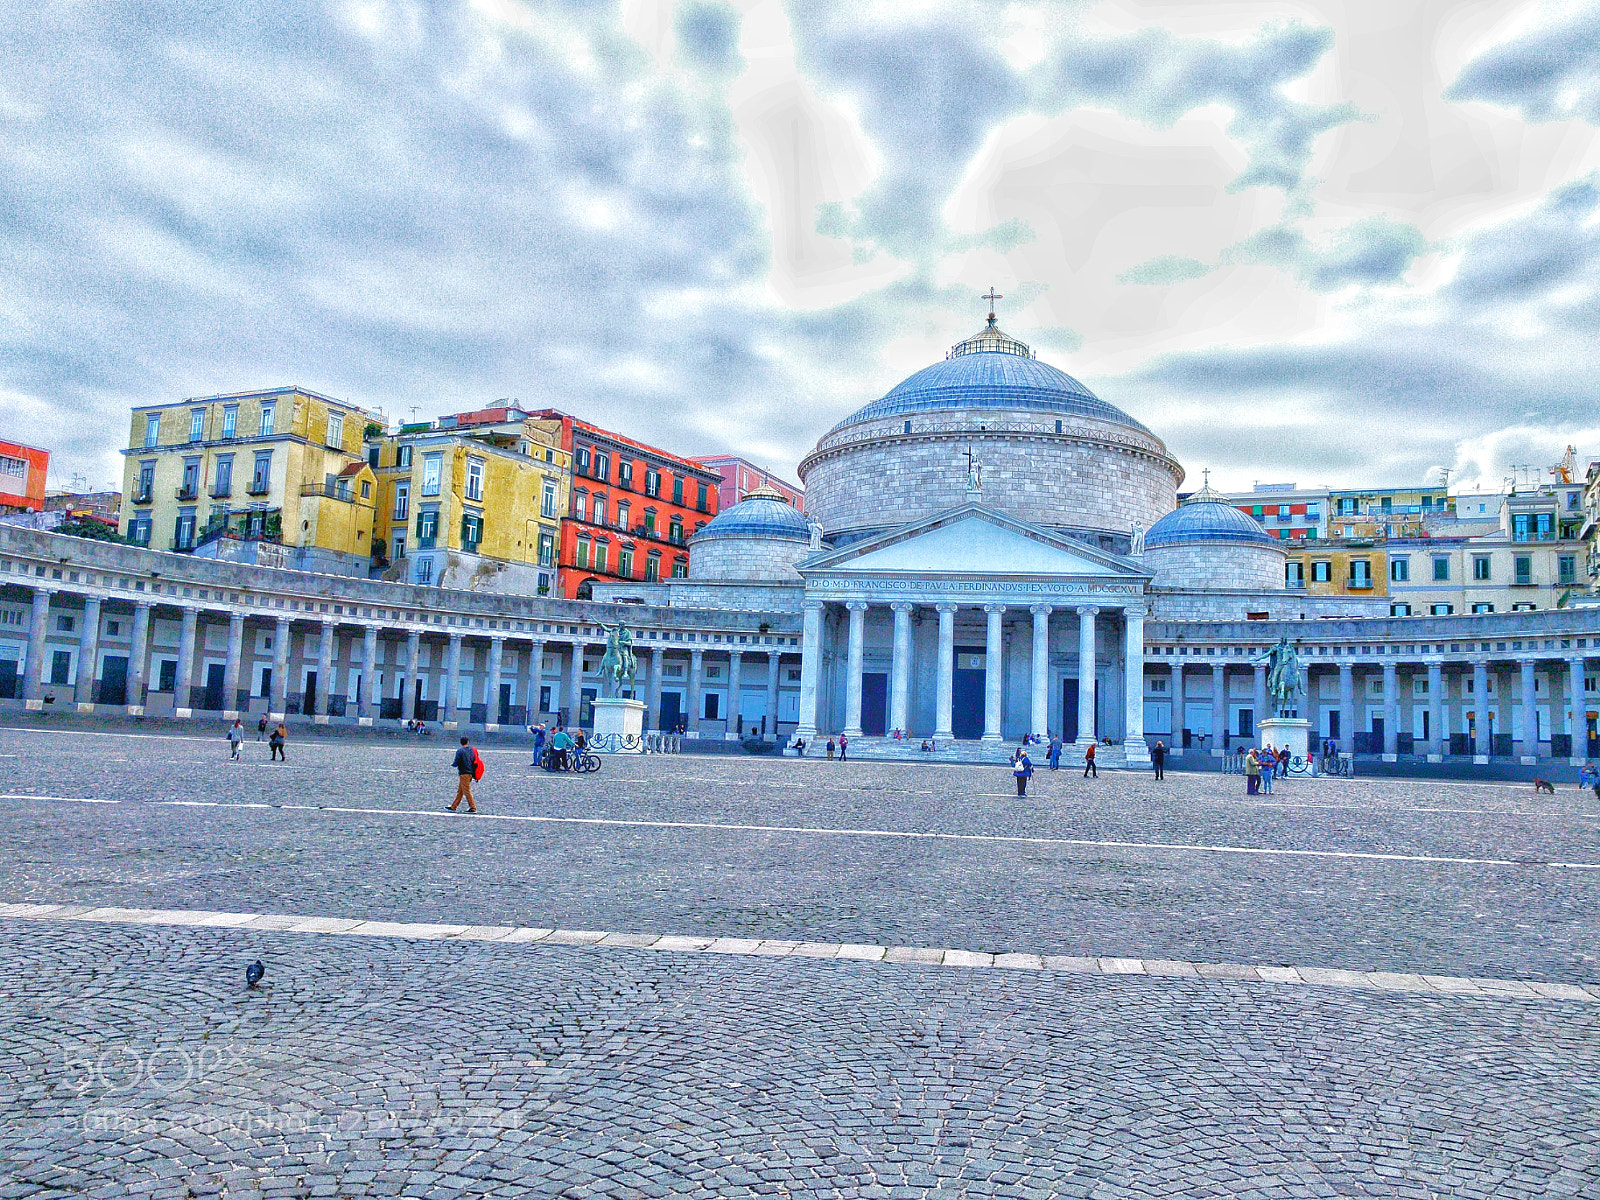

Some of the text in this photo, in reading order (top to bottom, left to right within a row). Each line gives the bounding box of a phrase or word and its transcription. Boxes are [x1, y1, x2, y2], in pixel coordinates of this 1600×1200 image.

[853, 580, 906, 589] FRANCISCO
[910, 582, 922, 590] DE
[925, 582, 955, 590] PAVLA
[958, 582, 1024, 592] FERDINANDVS
[1047, 584, 1074, 592] VOTO
[1088, 585, 1137, 594] MDCCCXVI
